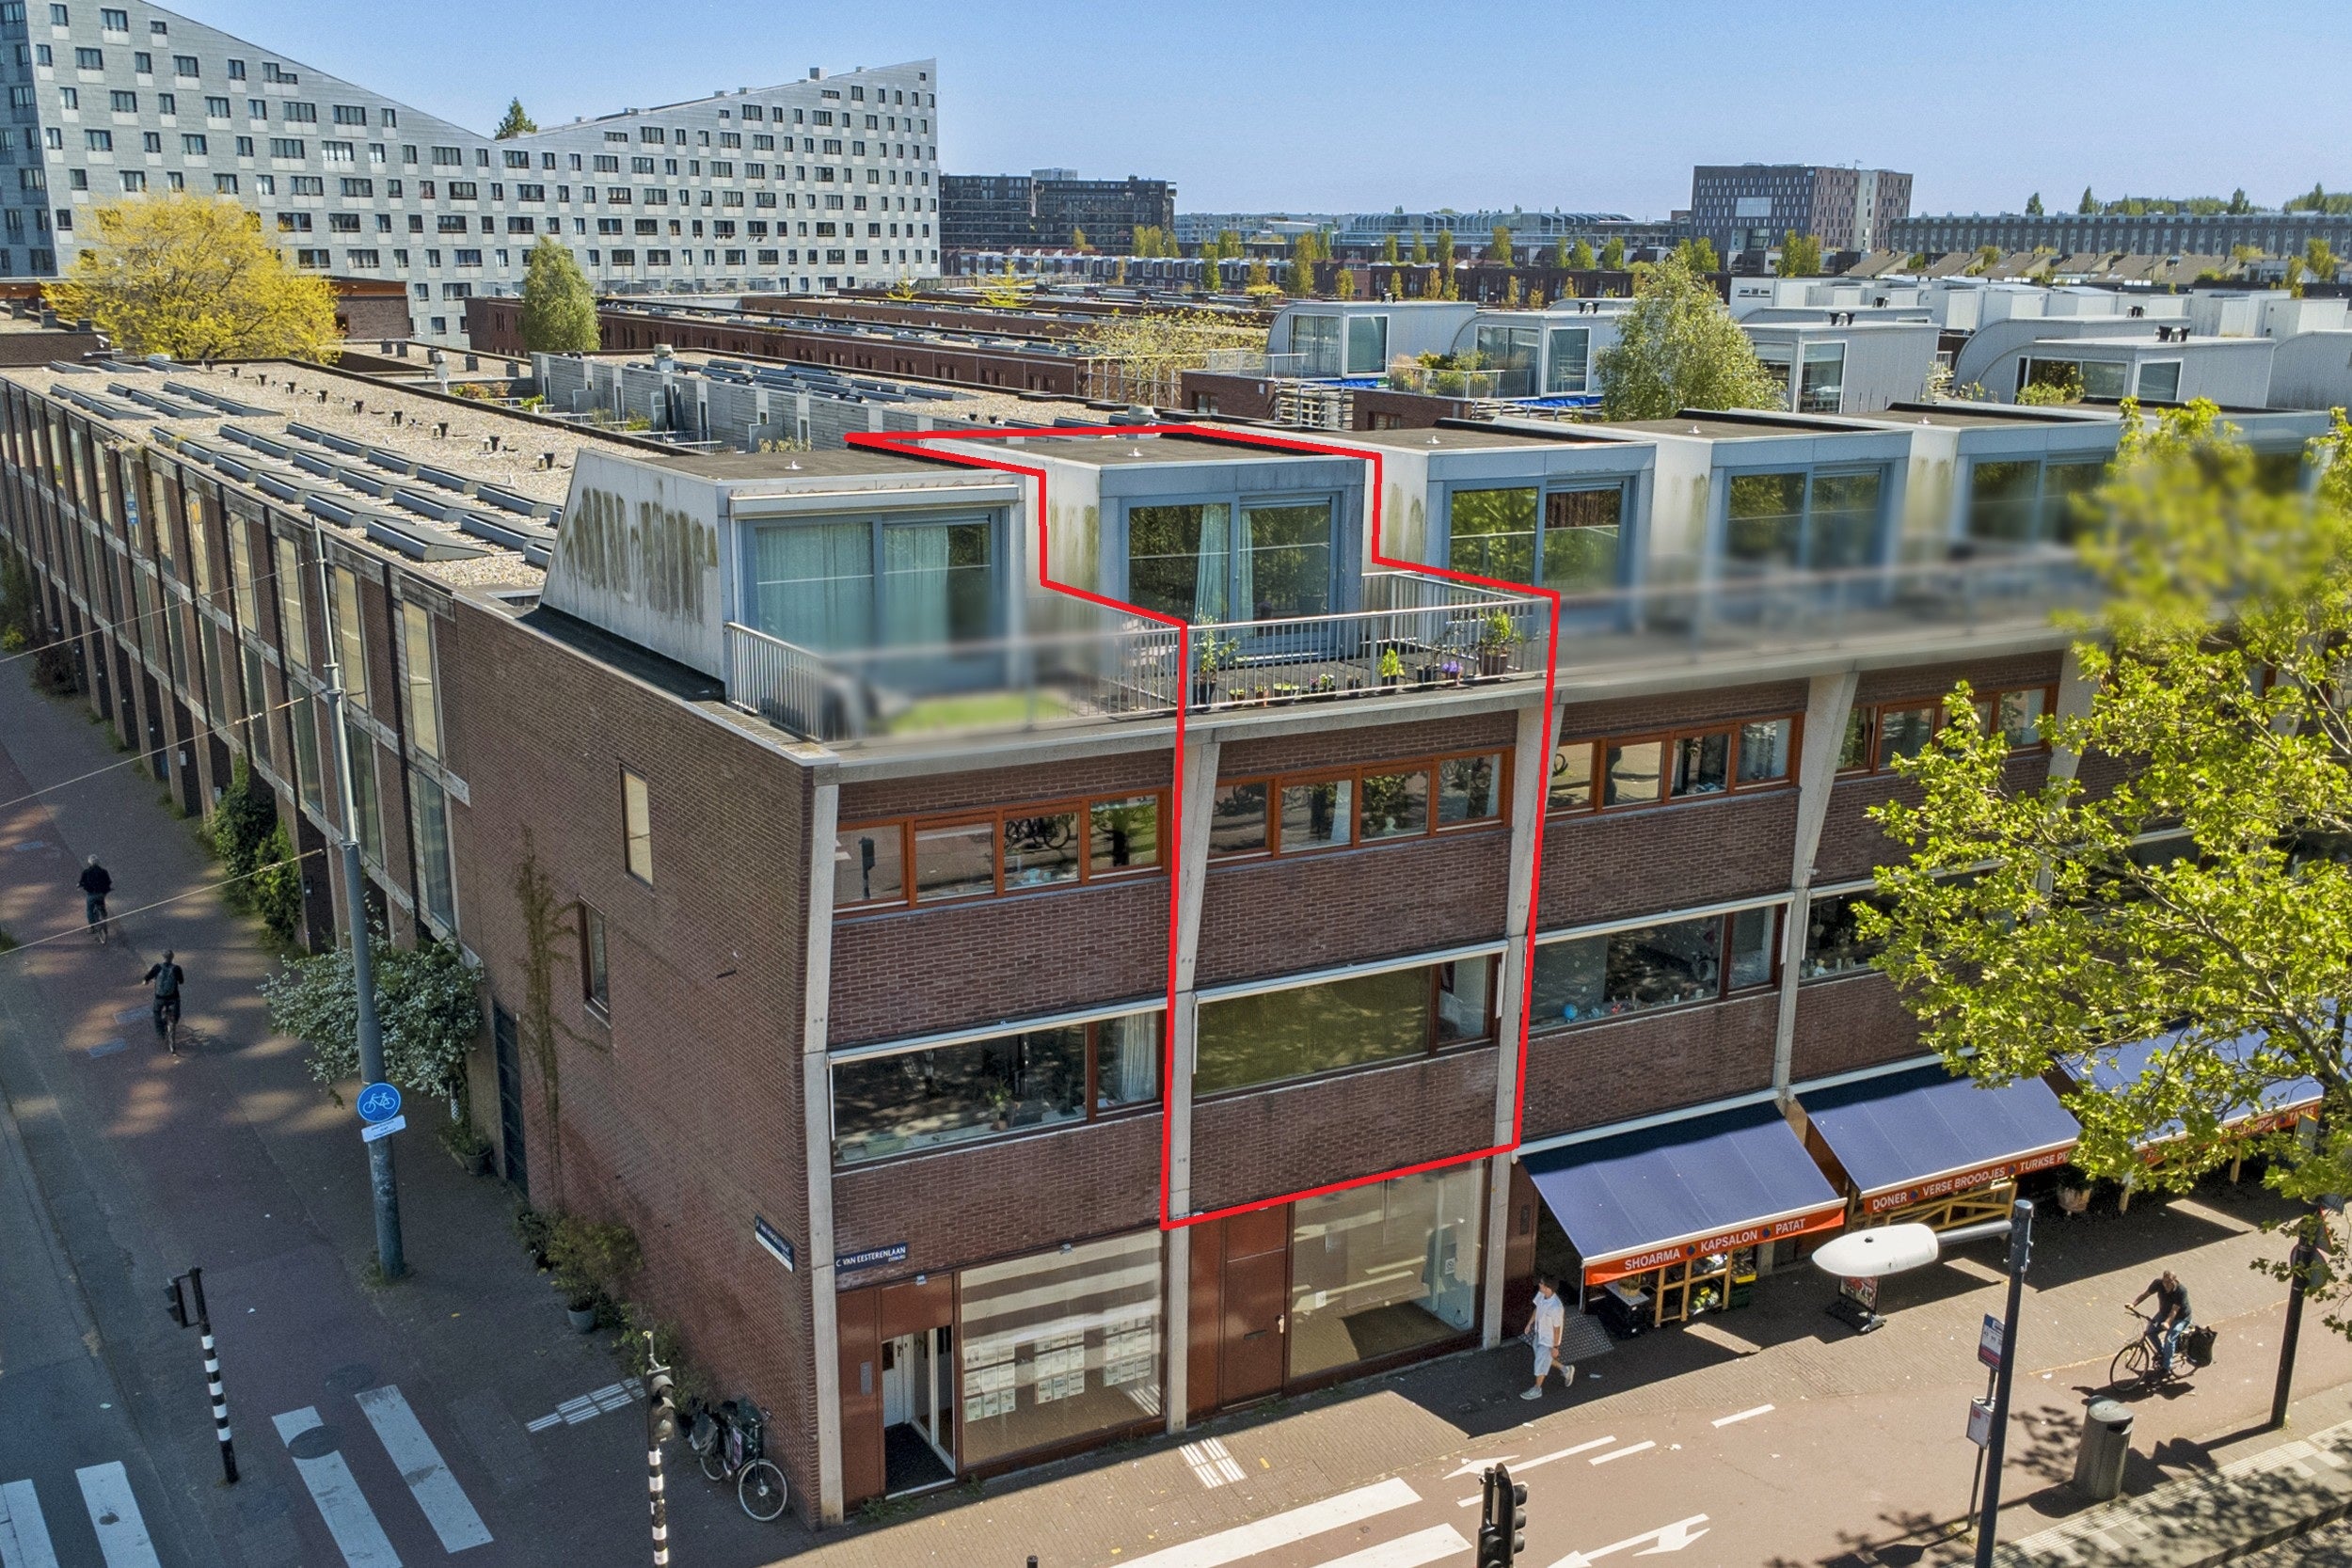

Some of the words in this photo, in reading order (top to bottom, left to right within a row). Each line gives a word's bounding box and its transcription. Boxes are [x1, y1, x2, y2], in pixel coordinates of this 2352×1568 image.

[1872, 1192, 1908, 1211] DONER
[1922, 1180, 1953, 1196] VERSE
[1954, 1166, 2006, 1188] BROODJES
[2019, 1154, 2056, 1172] TURKSE
[1624, 1248, 1681, 1271] SHOARMA
[1700, 1229, 1758, 1252] KAPSALON
[1775, 1217, 1806, 1235] PATAT
